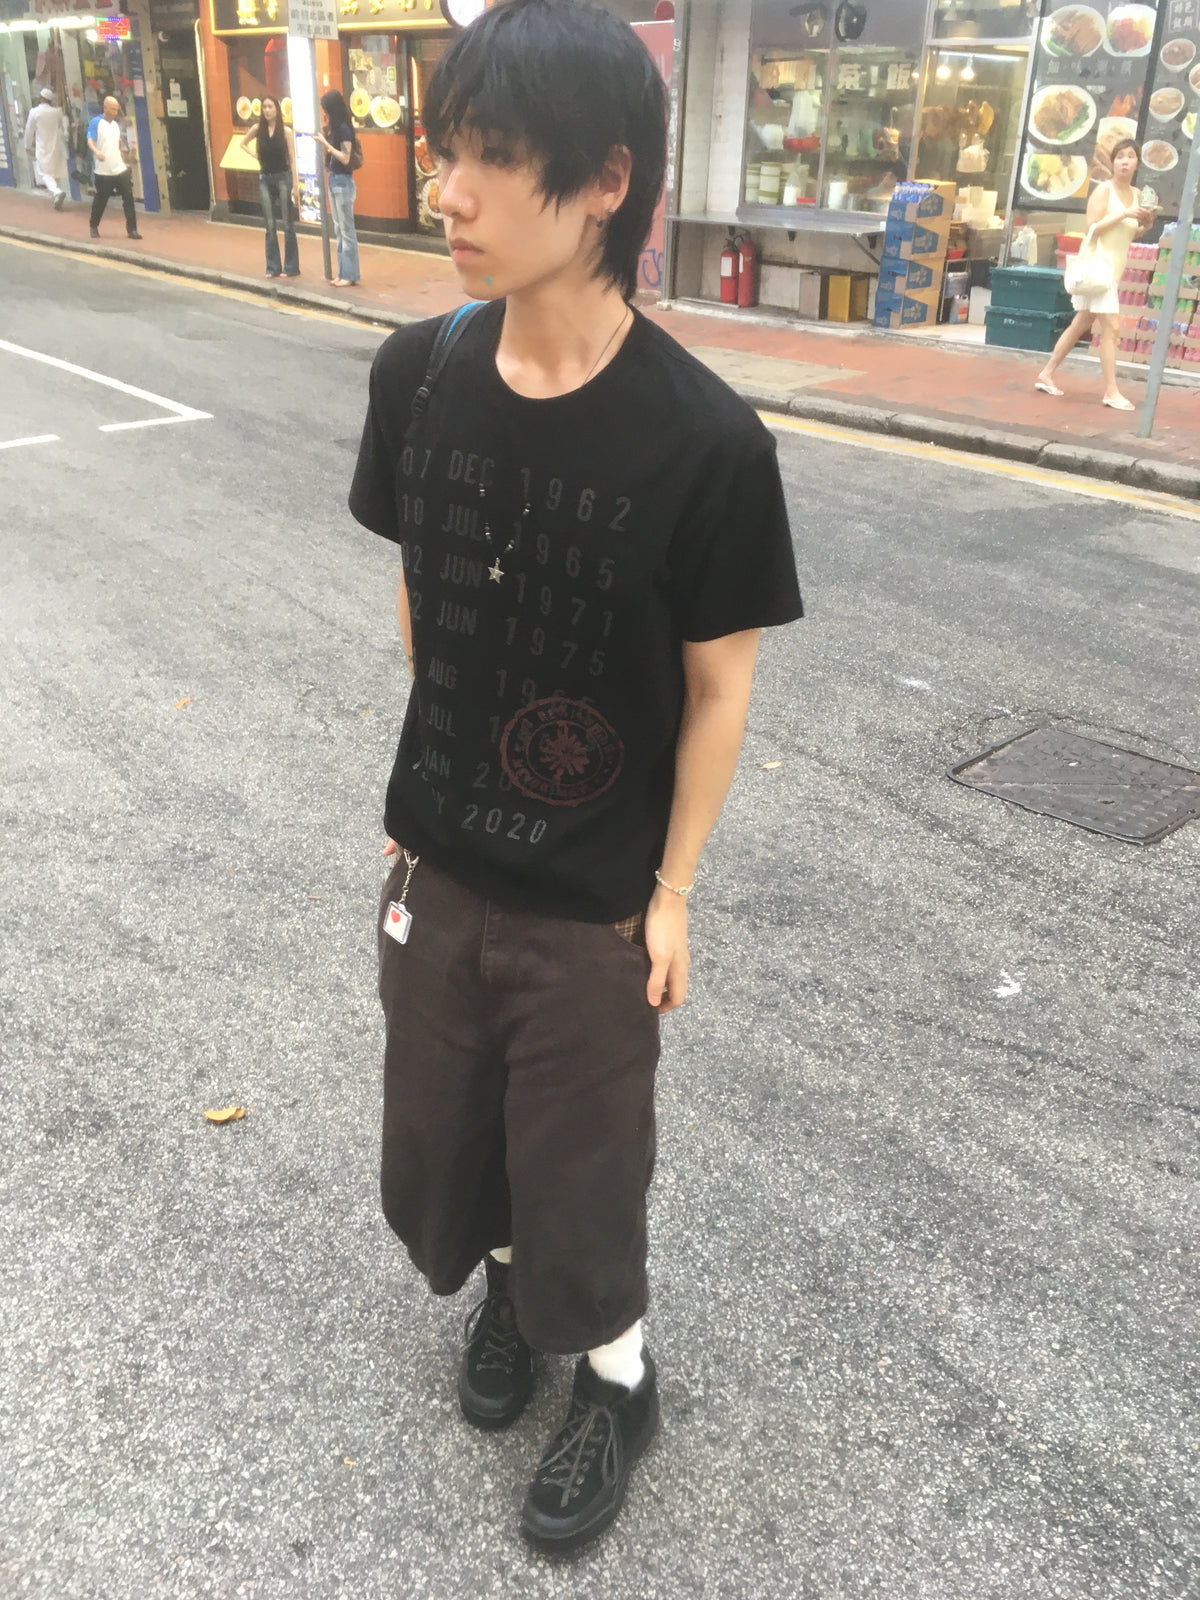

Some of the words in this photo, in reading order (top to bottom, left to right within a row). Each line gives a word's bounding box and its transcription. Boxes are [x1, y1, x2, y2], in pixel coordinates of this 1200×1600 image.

[448, 449, 495, 487] DEC
[520, 467, 632, 532] 1962
[402, 493, 425, 526] 10
[441, 503, 482, 541] JUL
[439, 553, 484, 588] JUN
[515, 572, 613, 637] 1971
[436, 600, 478, 636] JUN
[506, 617, 606, 677] 1975
[428, 657, 457, 690] AUG
[427, 704, 457, 737] JUL
[461, 804, 547, 844] 2020
